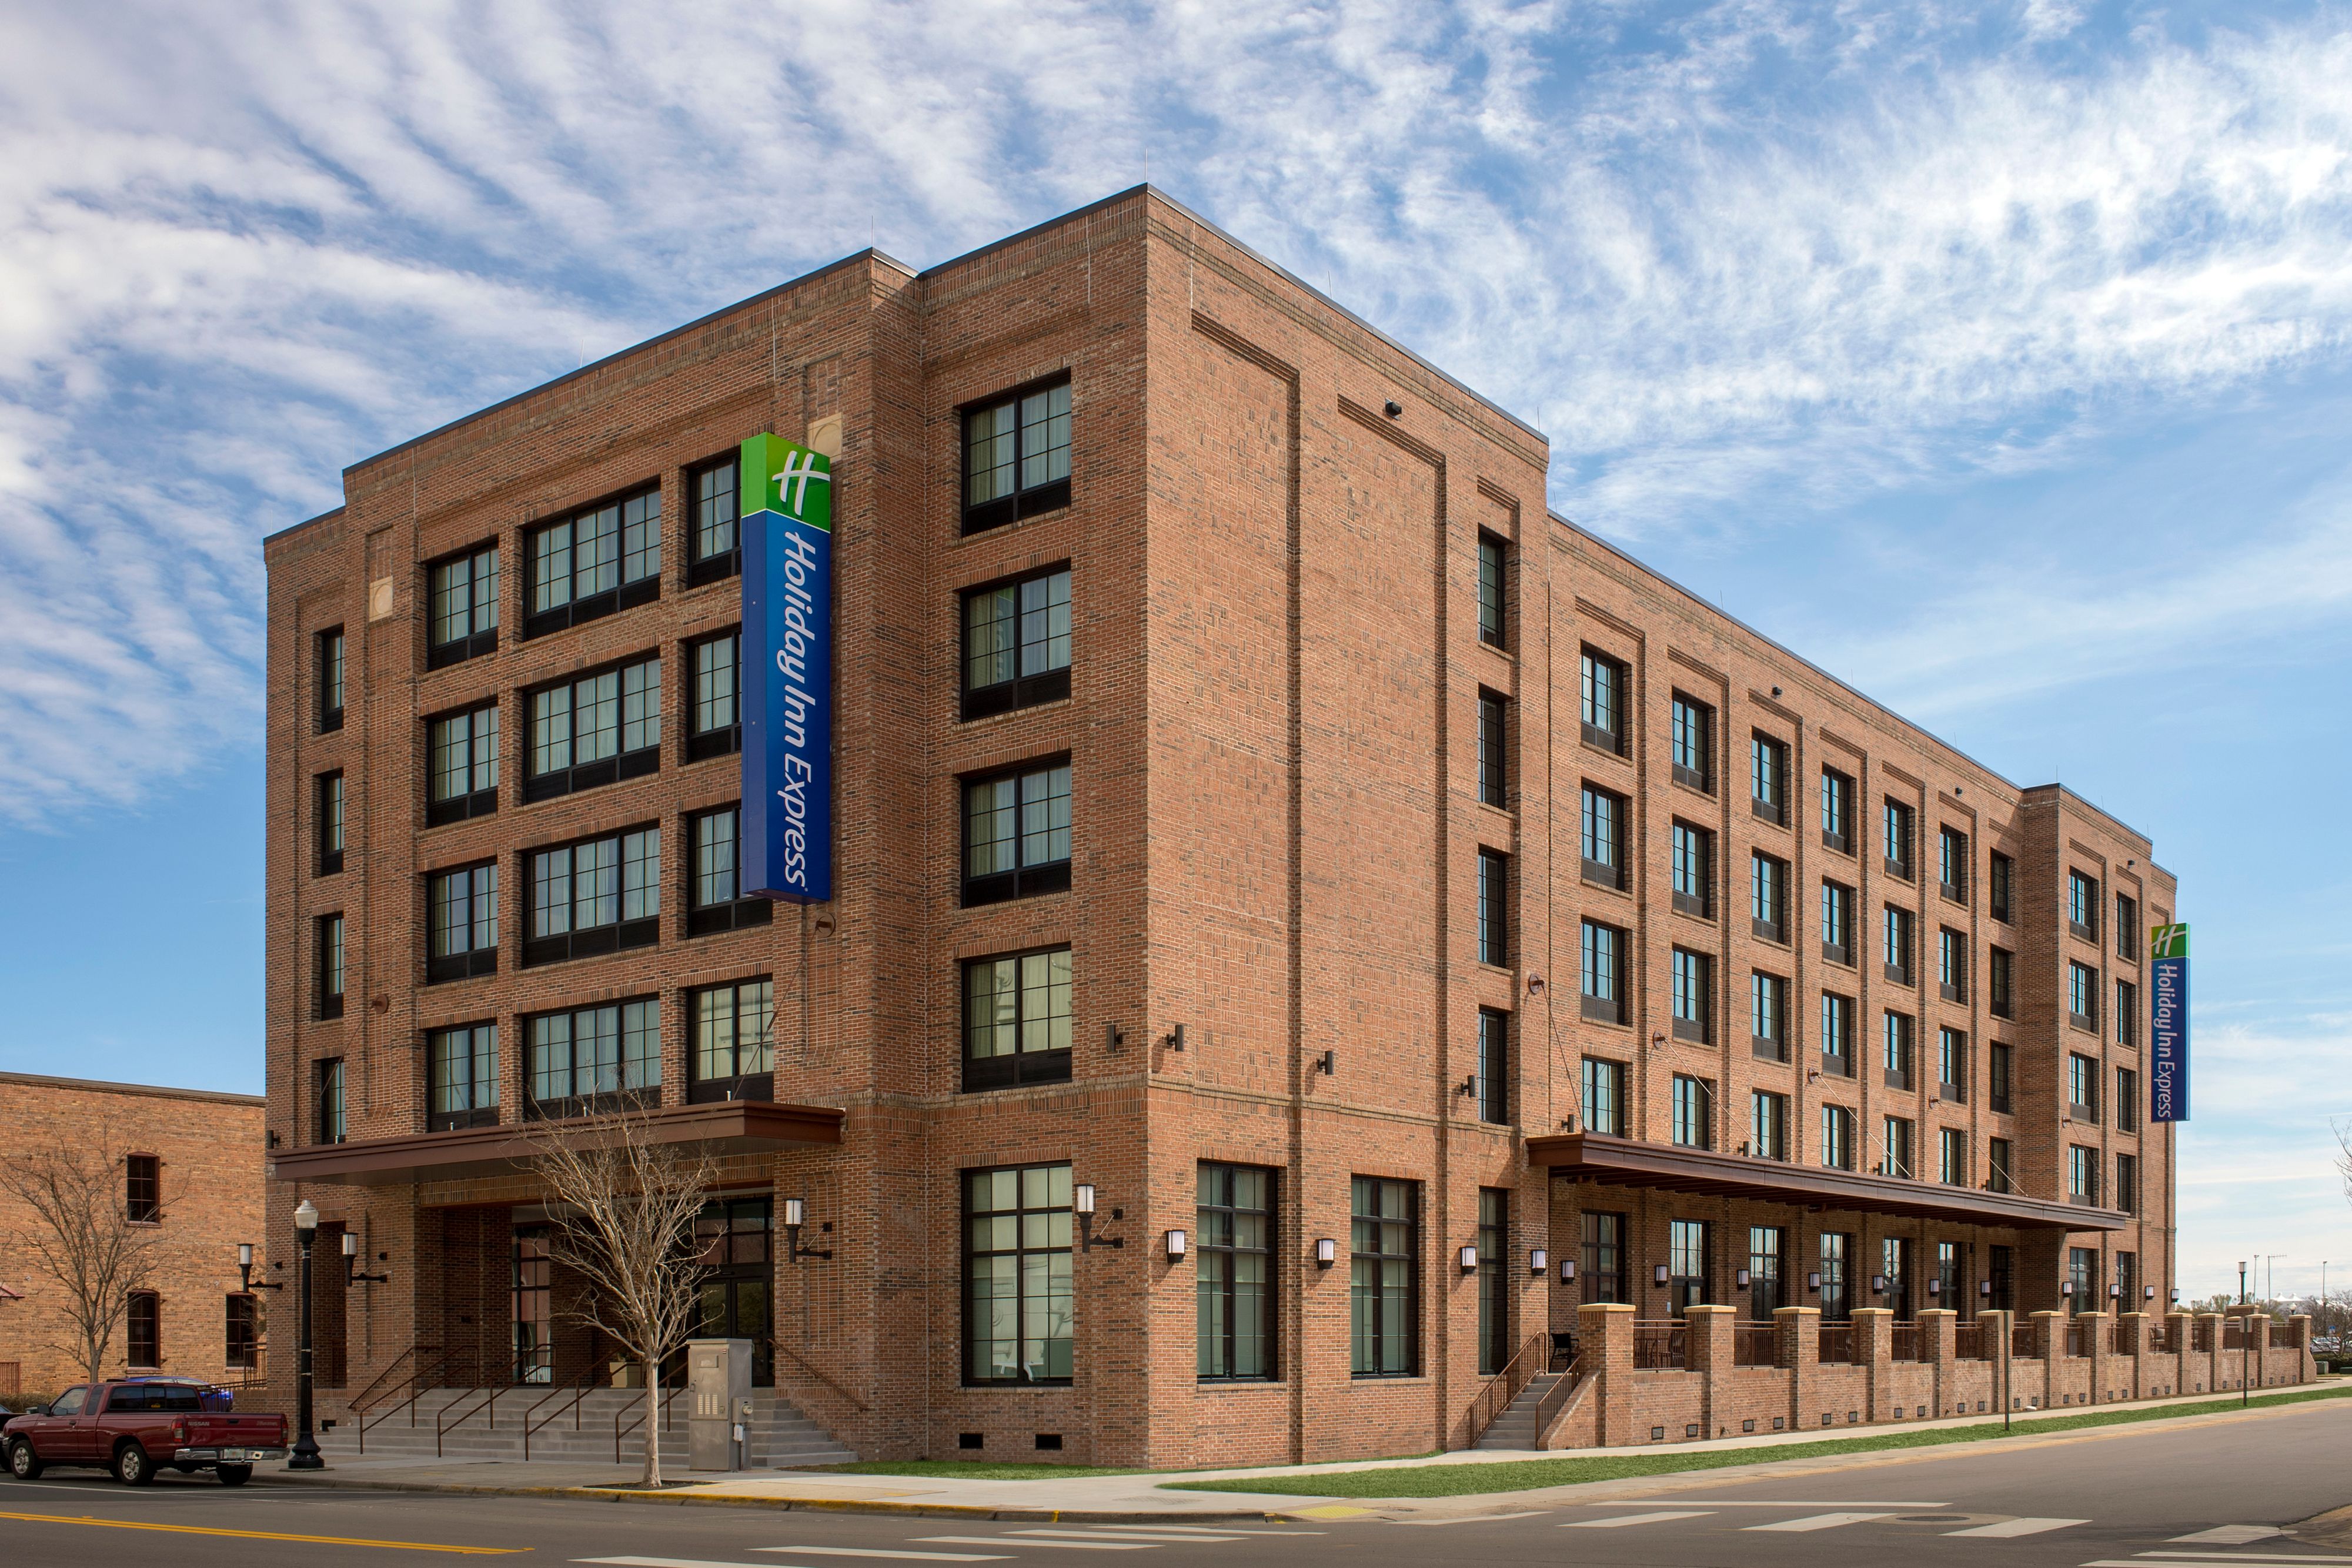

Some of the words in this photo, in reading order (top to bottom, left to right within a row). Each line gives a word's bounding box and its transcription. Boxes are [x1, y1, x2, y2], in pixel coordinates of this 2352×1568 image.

[777, 531, 816, 684] Holiday
[784, 684, 816, 747] Inn
[777, 753, 811, 888] Express
[2153, 964, 2177, 1029] Holiday
[2158, 1032, 2177, 1058] Inn
[2154, 1061, 2175, 1118] Express
